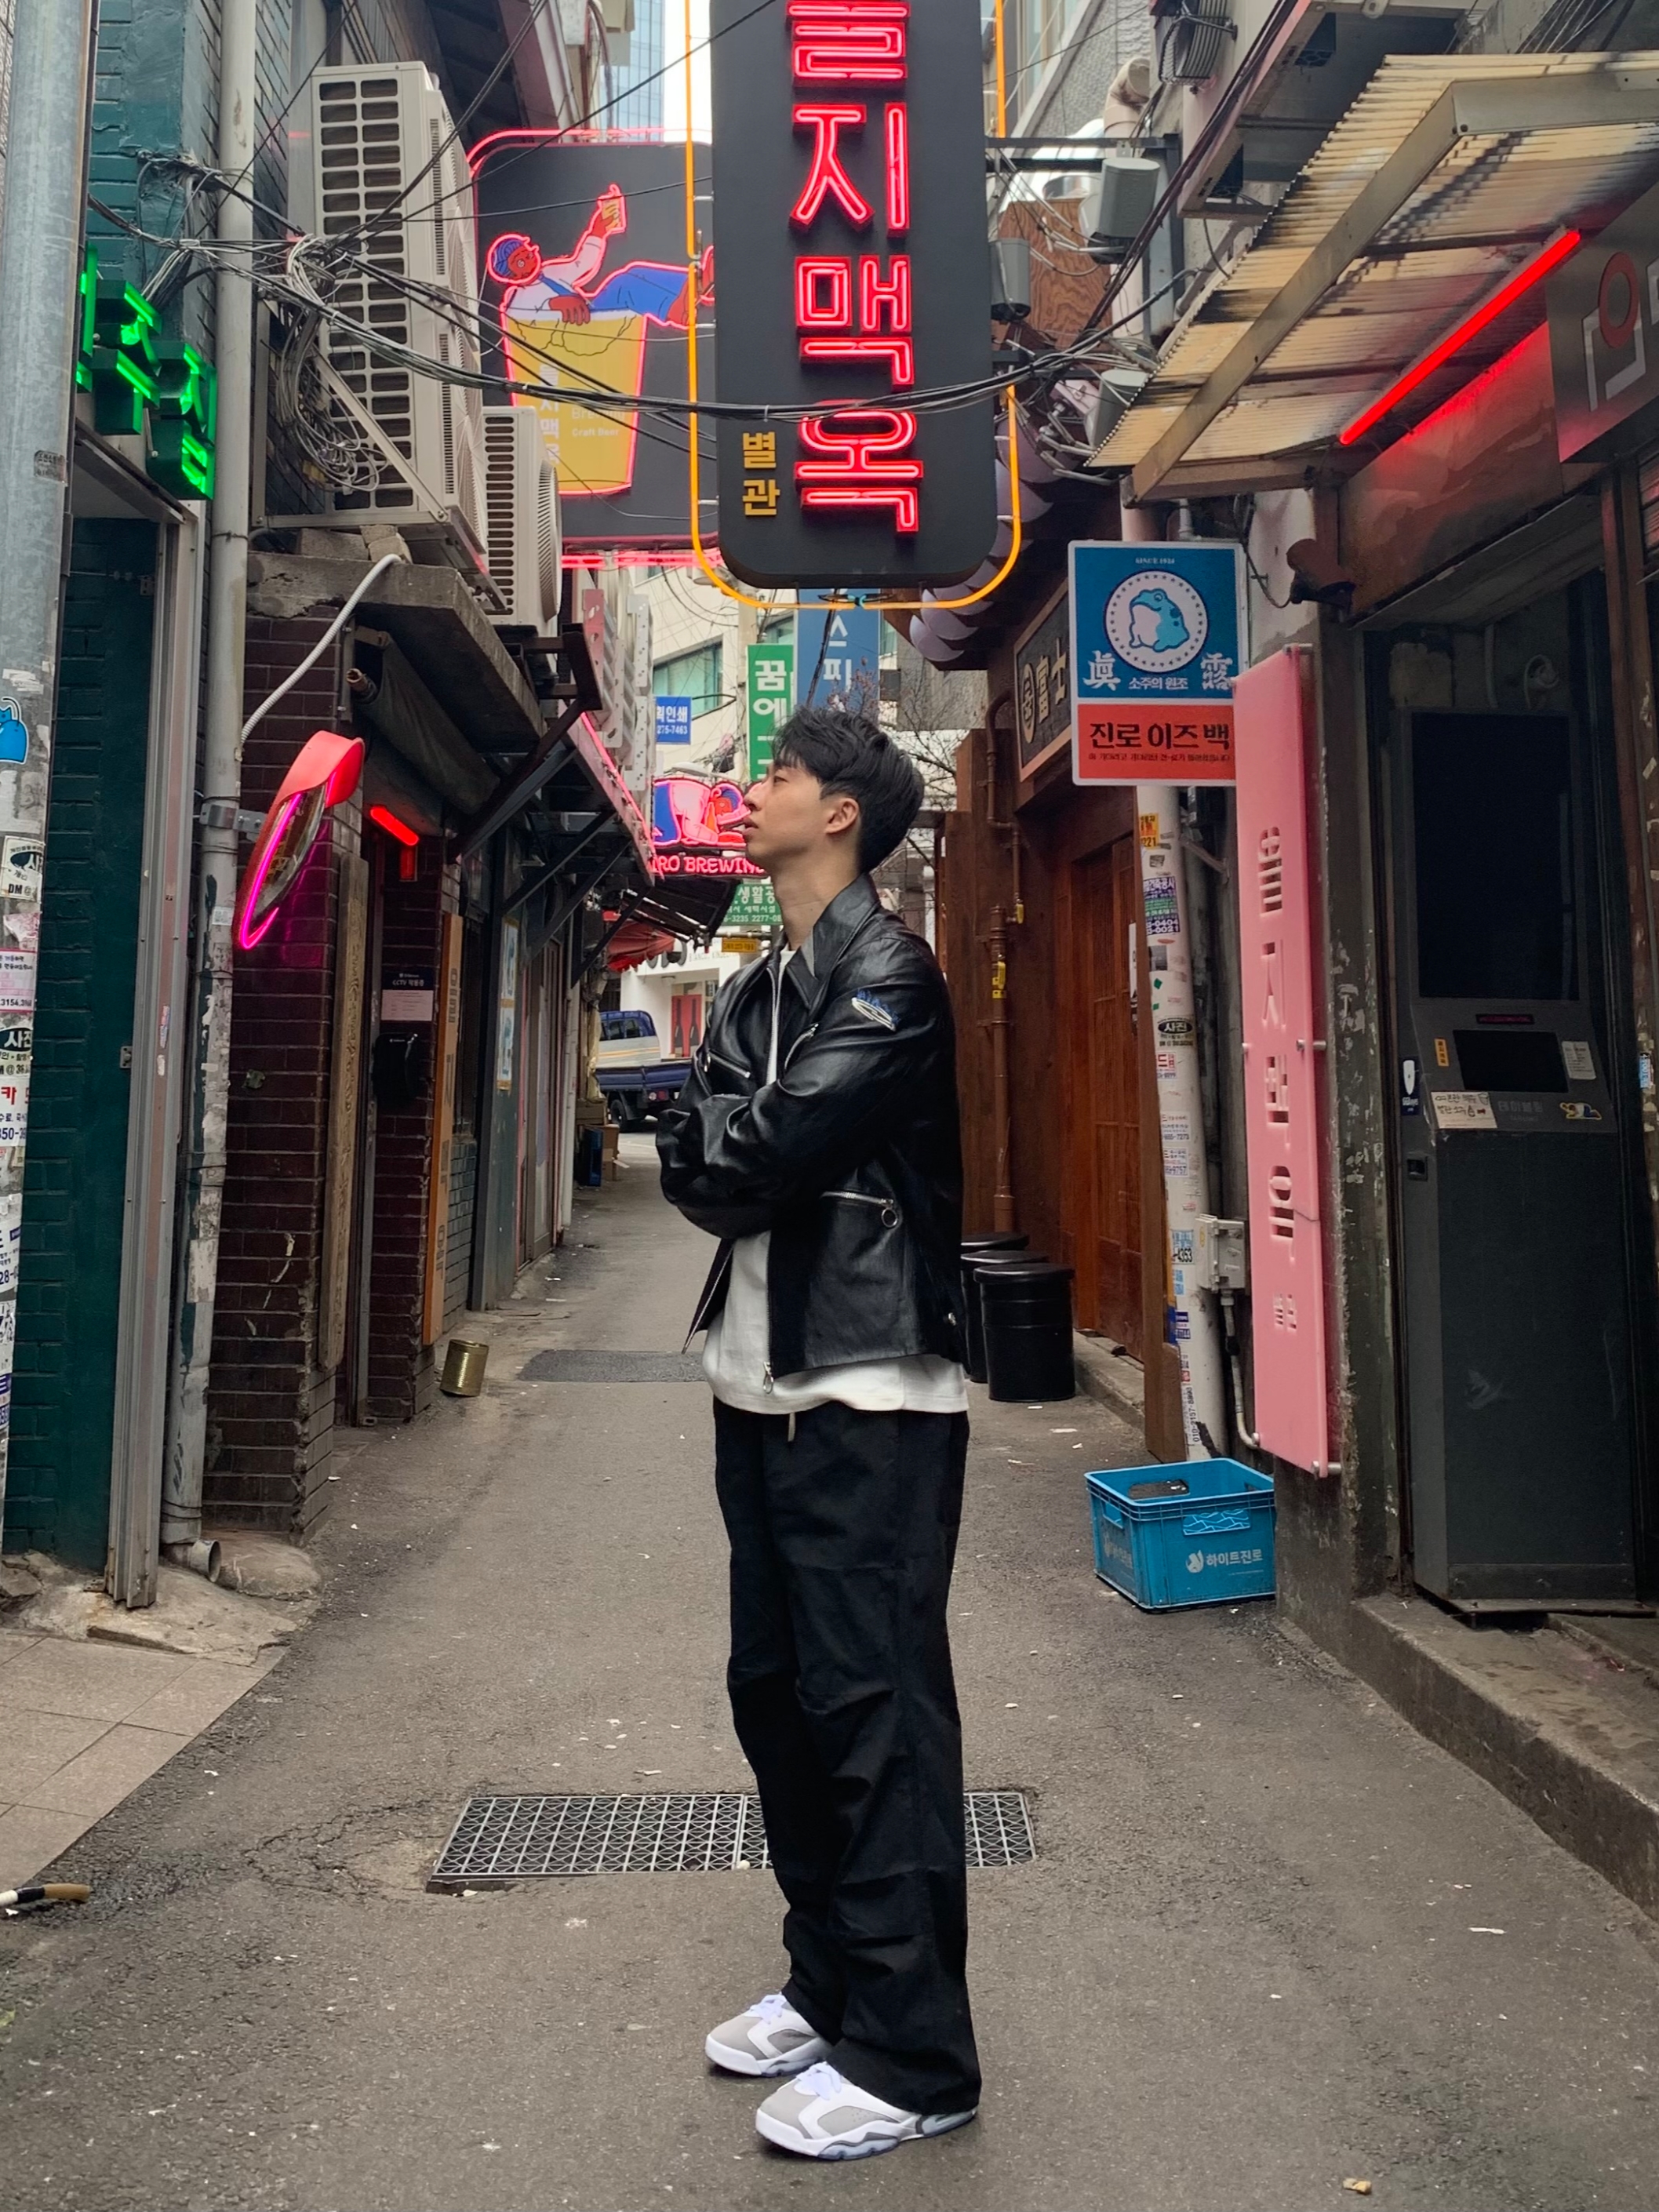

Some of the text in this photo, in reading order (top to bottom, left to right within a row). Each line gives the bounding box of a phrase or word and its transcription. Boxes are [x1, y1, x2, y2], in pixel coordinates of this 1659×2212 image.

[742, 431, 780, 516] 별관
[1128, 677, 1188, 690] 소주의 원조
[1090, 722, 1230, 750] 진로 이즈 백
[9, 883, 22, 894] DM
[1164, 1022, 1188, 1033] 사진
[1206, 1548, 1264, 1567] 하이트진로
